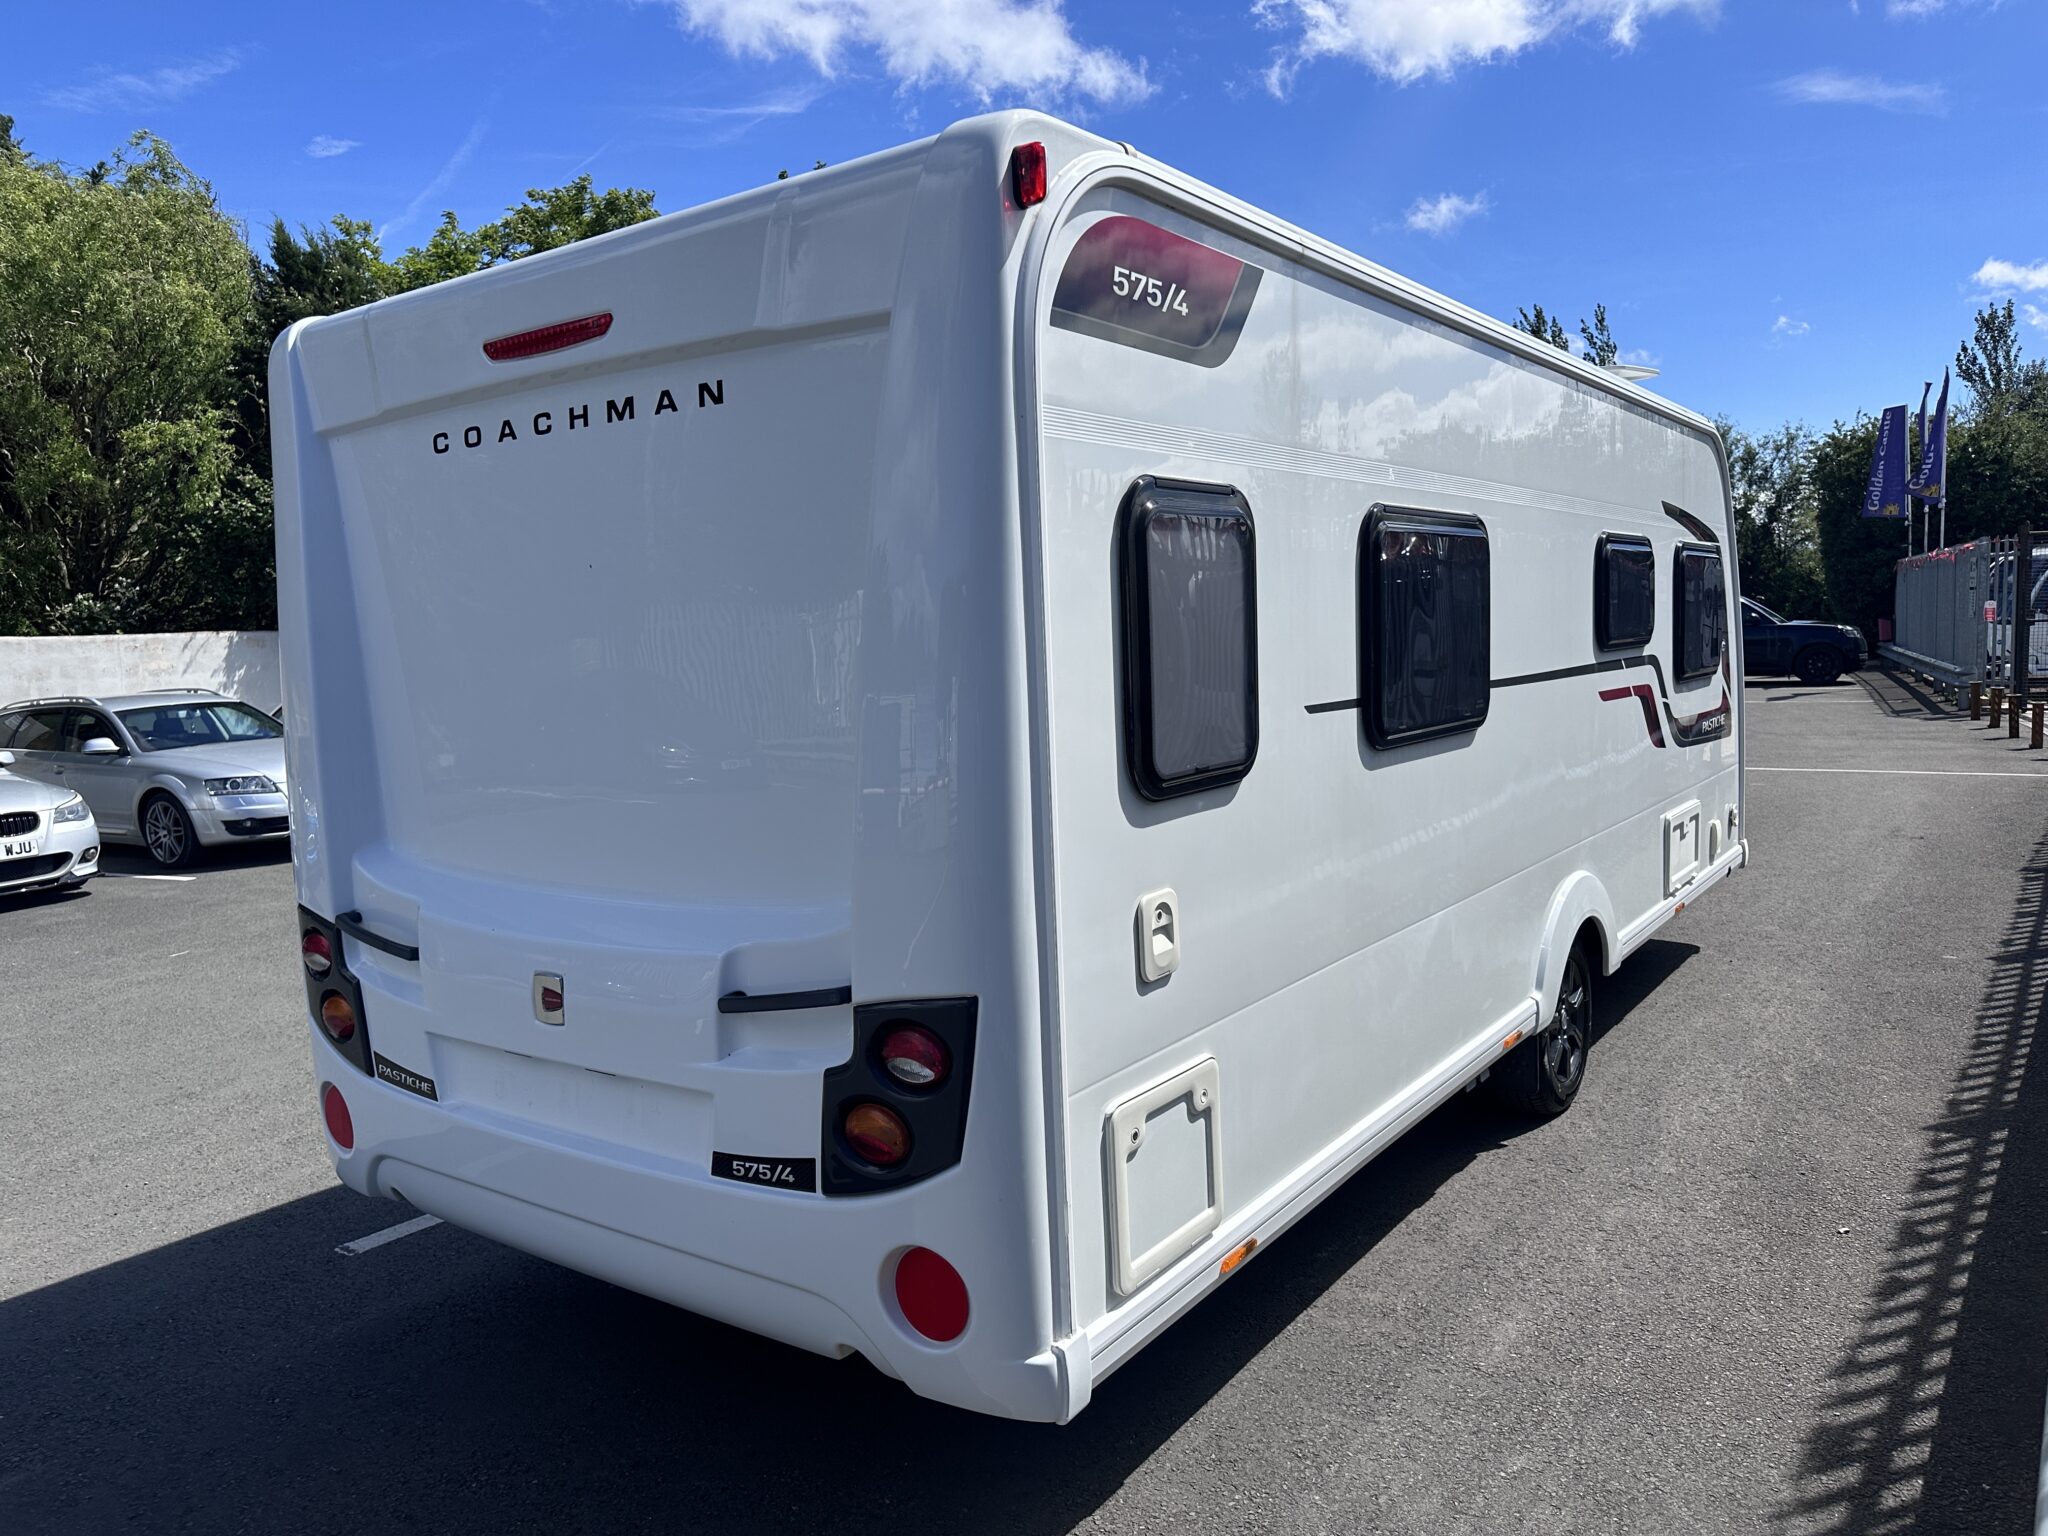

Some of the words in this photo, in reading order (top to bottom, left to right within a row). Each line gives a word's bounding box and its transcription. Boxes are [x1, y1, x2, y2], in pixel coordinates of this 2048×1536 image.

[1112, 265, 1189, 317] 575/4
[432, 379, 724, 454] COACHMAN
[1867, 460, 1885, 511] Golden
[1702, 713, 1726, 733] PASTICHE
[4, 841, 32, 857] WJU
[378, 1064, 433, 1094] PASTICHE
[732, 1160, 796, 1183] 575/4
